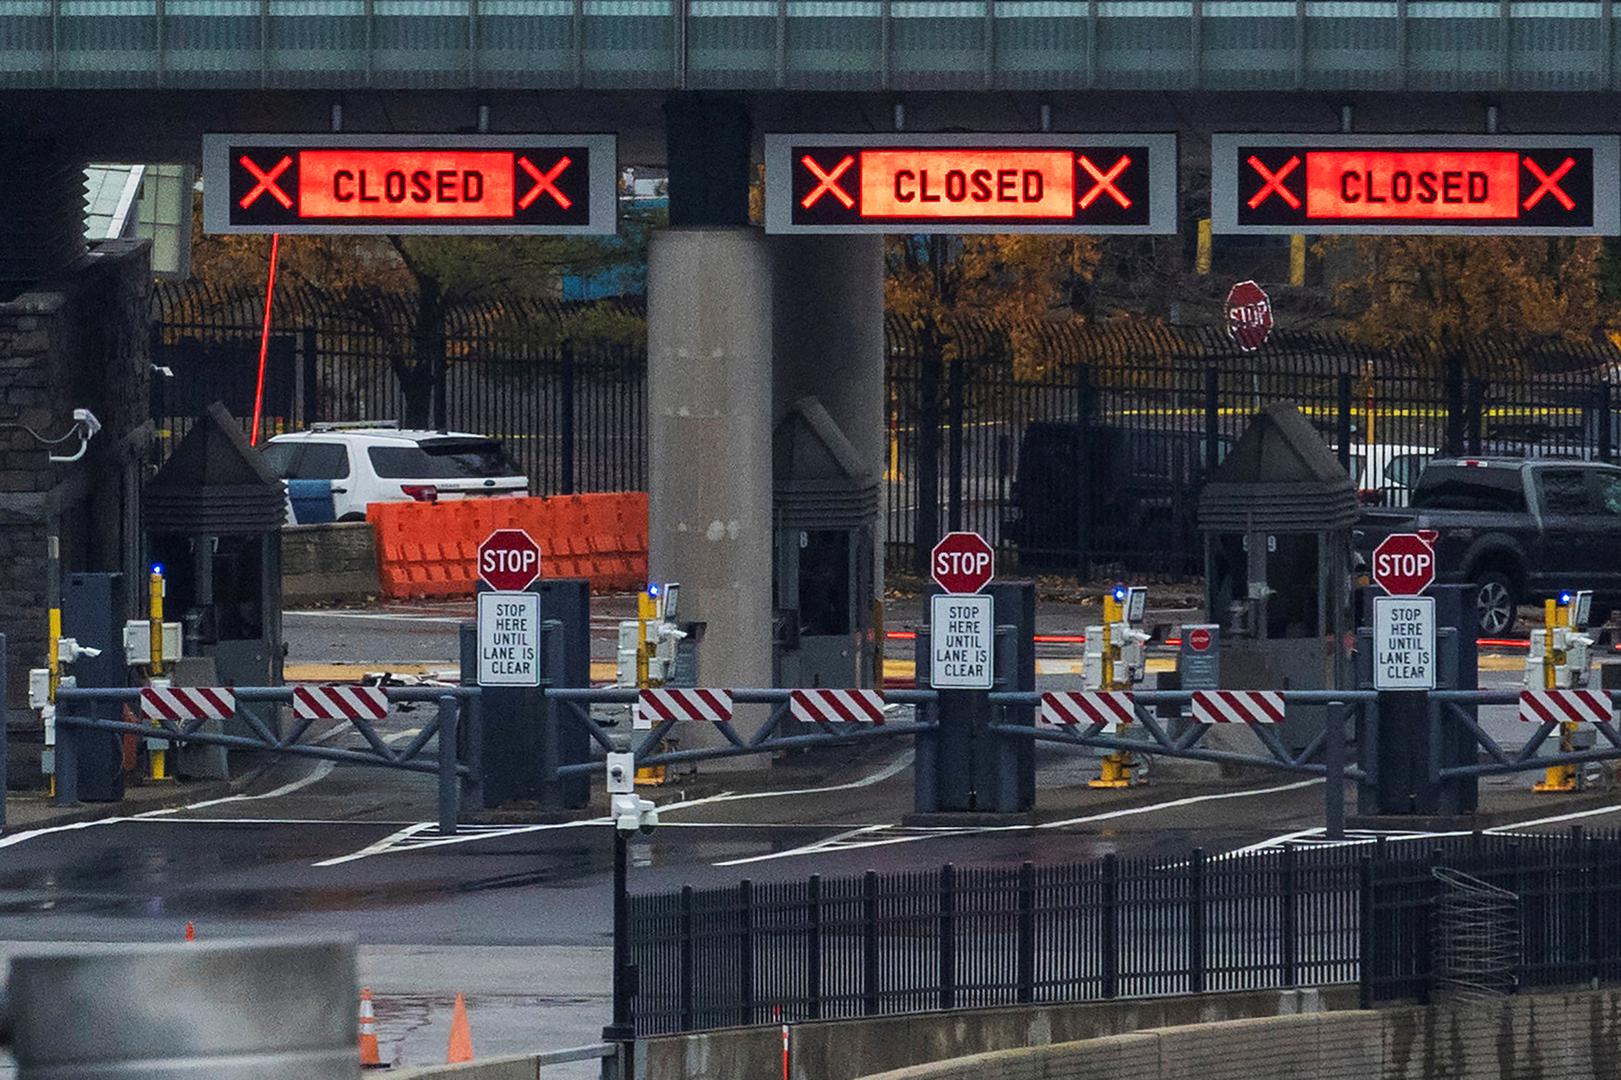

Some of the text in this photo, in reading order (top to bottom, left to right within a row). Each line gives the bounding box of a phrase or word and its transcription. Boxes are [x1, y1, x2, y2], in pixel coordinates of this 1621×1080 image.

[333, 169, 484, 203] CLOSED
[894, 169, 1044, 203] CLOSED
[1340, 170, 1489, 204] CLOSED
[482, 549, 536, 573] STOP
[936, 552, 989, 575] STOP
[1377, 554, 1431, 577] STOP
[496, 604, 526, 617] STOP
[949, 606, 979, 619] STOP
[1391, 608, 1421, 621] STOP
[496, 618, 527, 632] HERE
[949, 621, 980, 634] HERE
[1391, 623, 1423, 636] HERE
[493, 633, 528, 646] UNTIL
[946, 635, 981, 648] UNTIL
[1388, 638, 1423, 650] UNTIL
[483, 647, 535, 660] LANE IS
[936, 650, 987, 663] LANE IS
[1379, 652, 1430, 665] LANE IS
[491, 661, 530, 674] CLEAR
[944, 664, 983, 677] CLEAR
[1387, 666, 1425, 679] CLEAR
